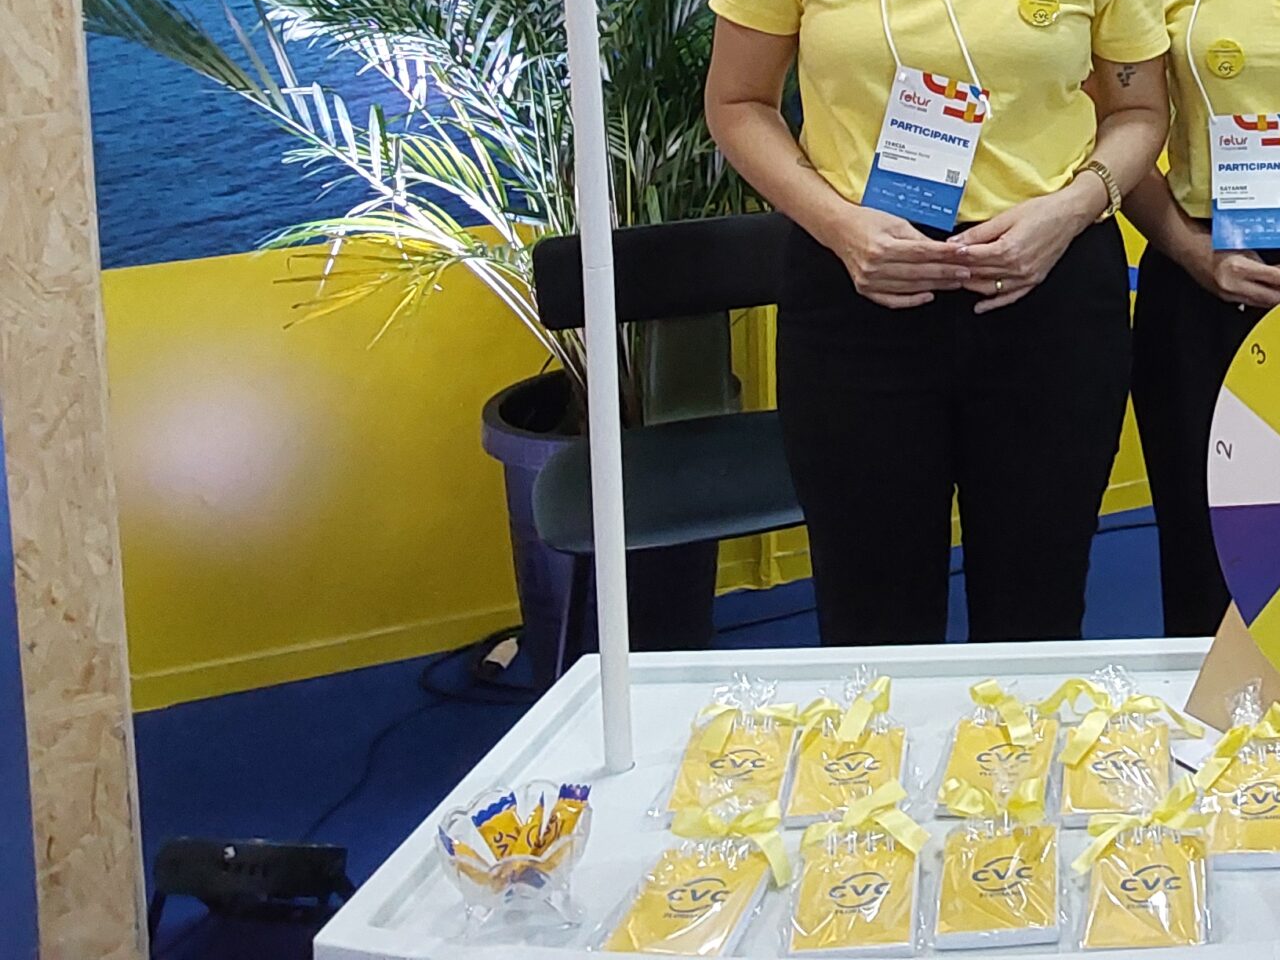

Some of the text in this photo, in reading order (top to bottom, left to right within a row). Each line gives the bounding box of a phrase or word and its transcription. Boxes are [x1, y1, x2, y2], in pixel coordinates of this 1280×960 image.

[1033, 12, 1049, 20] CVC
[1217, 64, 1236, 72] CVC
[890, 118, 970, 149] PARTICIPANTE
[1251, 343, 1266, 365] 3
[1216, 440, 1233, 460] 2
[709, 757, 767, 770] CVC
[976, 751, 1033, 764] CVC
[823, 759, 882, 773] CVC
[972, 865, 1035, 883] CVC
[828, 881, 891, 899] CVC
[1120, 876, 1183, 891] CVC
[667, 888, 732, 903] CVC
